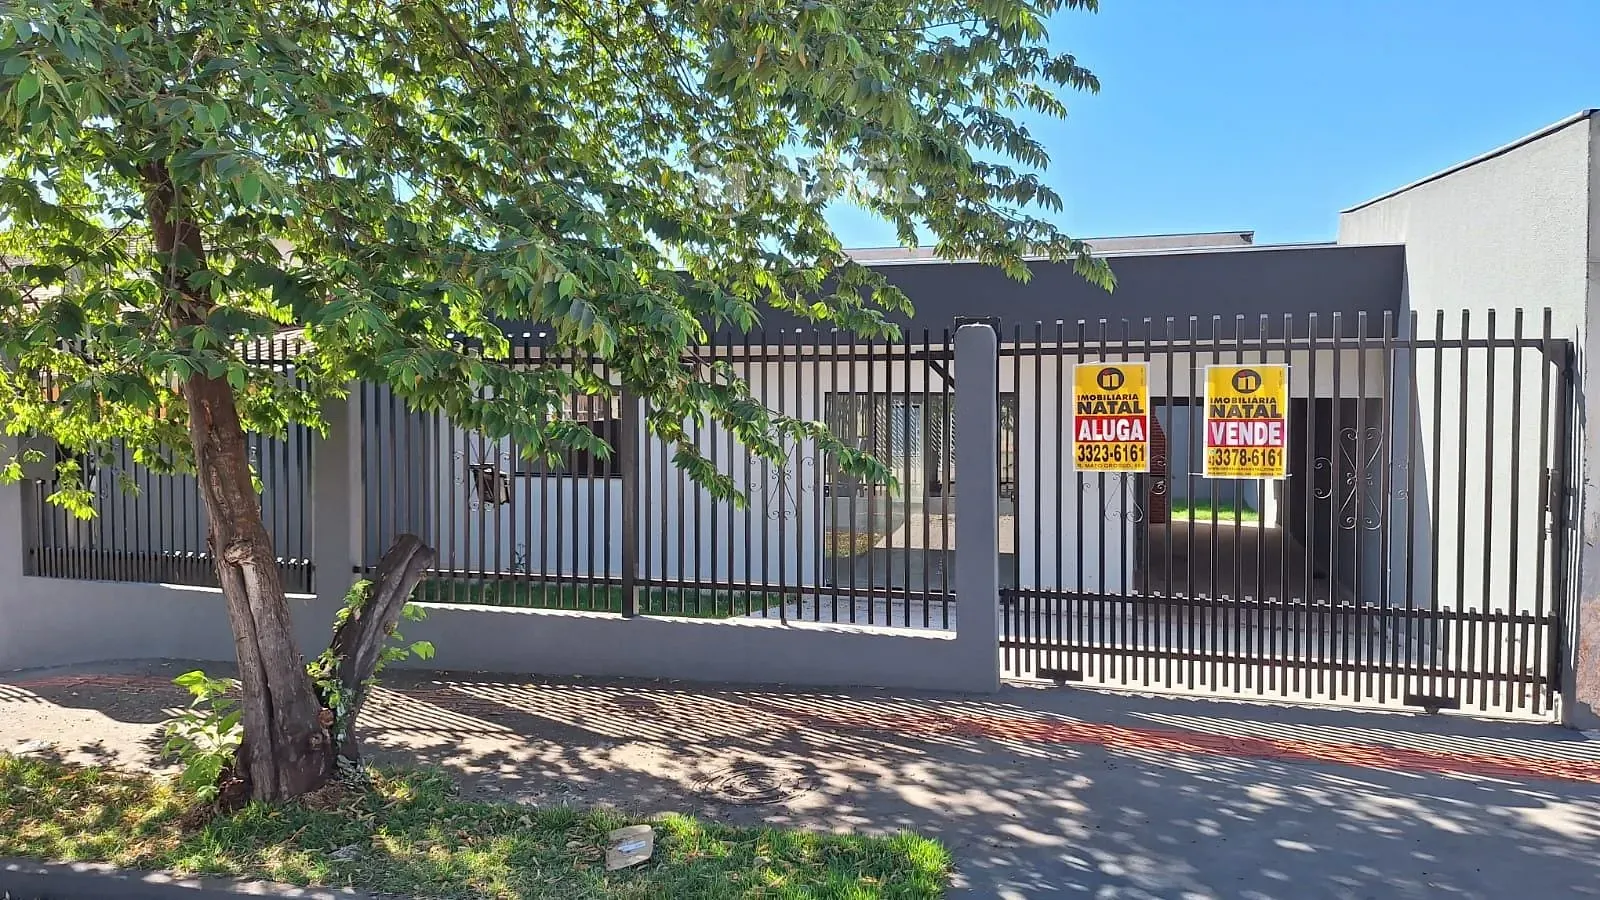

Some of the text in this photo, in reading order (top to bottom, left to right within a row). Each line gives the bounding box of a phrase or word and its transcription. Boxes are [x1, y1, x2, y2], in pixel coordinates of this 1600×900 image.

[1077, 401, 1144, 414] NATAL
[1210, 404, 1283, 418] NATAL
[1078, 418, 1145, 441] ALUGA
[1210, 421, 1281, 446] VENDE
[1077, 444, 1145, 462] 3323-6161
